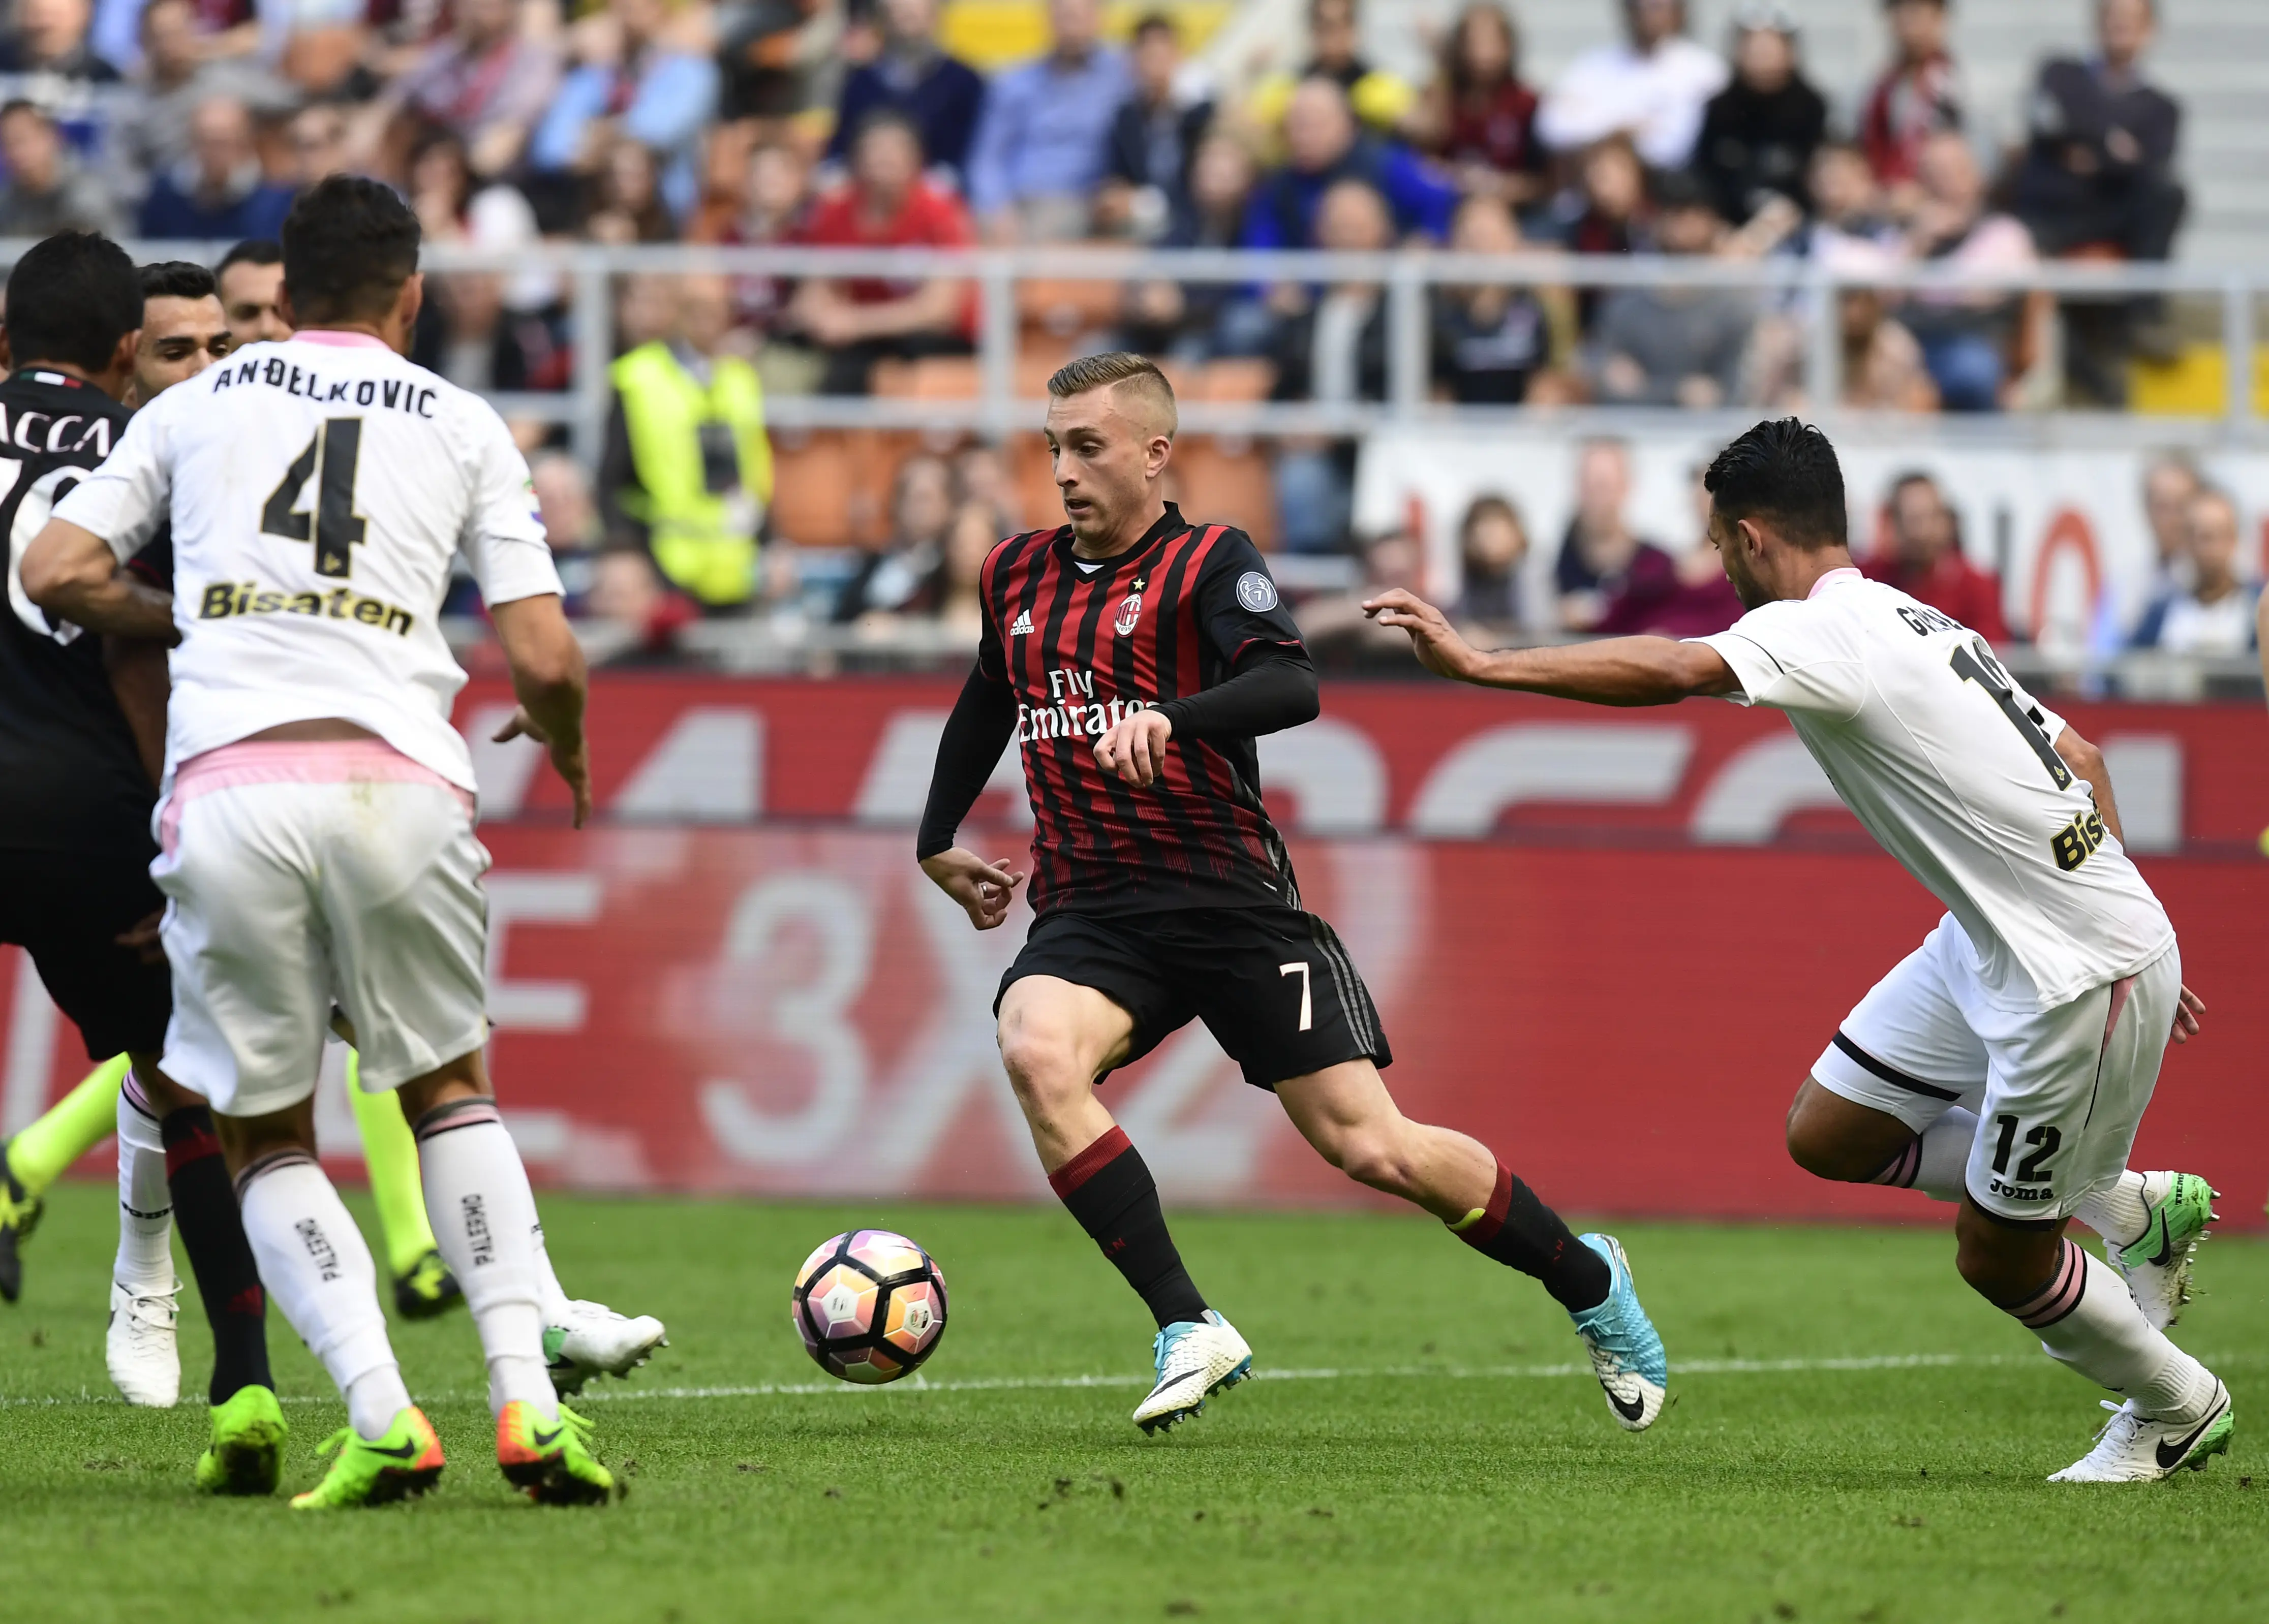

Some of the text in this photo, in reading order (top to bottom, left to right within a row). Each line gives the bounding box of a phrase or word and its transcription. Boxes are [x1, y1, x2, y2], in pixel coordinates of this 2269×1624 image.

[0, 402, 110, 457] CCA
[260, 416, 367, 580] 4
[199, 581, 413, 637] Bisaten
[1253, 590, 1262, 601] 7
[1009, 625, 1035, 637] adidas
[1048, 668, 1093, 699] Fly
[1018, 695, 1161, 743] Emirate
[2050, 800, 2108, 872] Bis
[1279, 962, 1312, 1032] 7
[1992, 1115, 2062, 1182] 12
[1990, 1178, 2054, 1200] Joma
